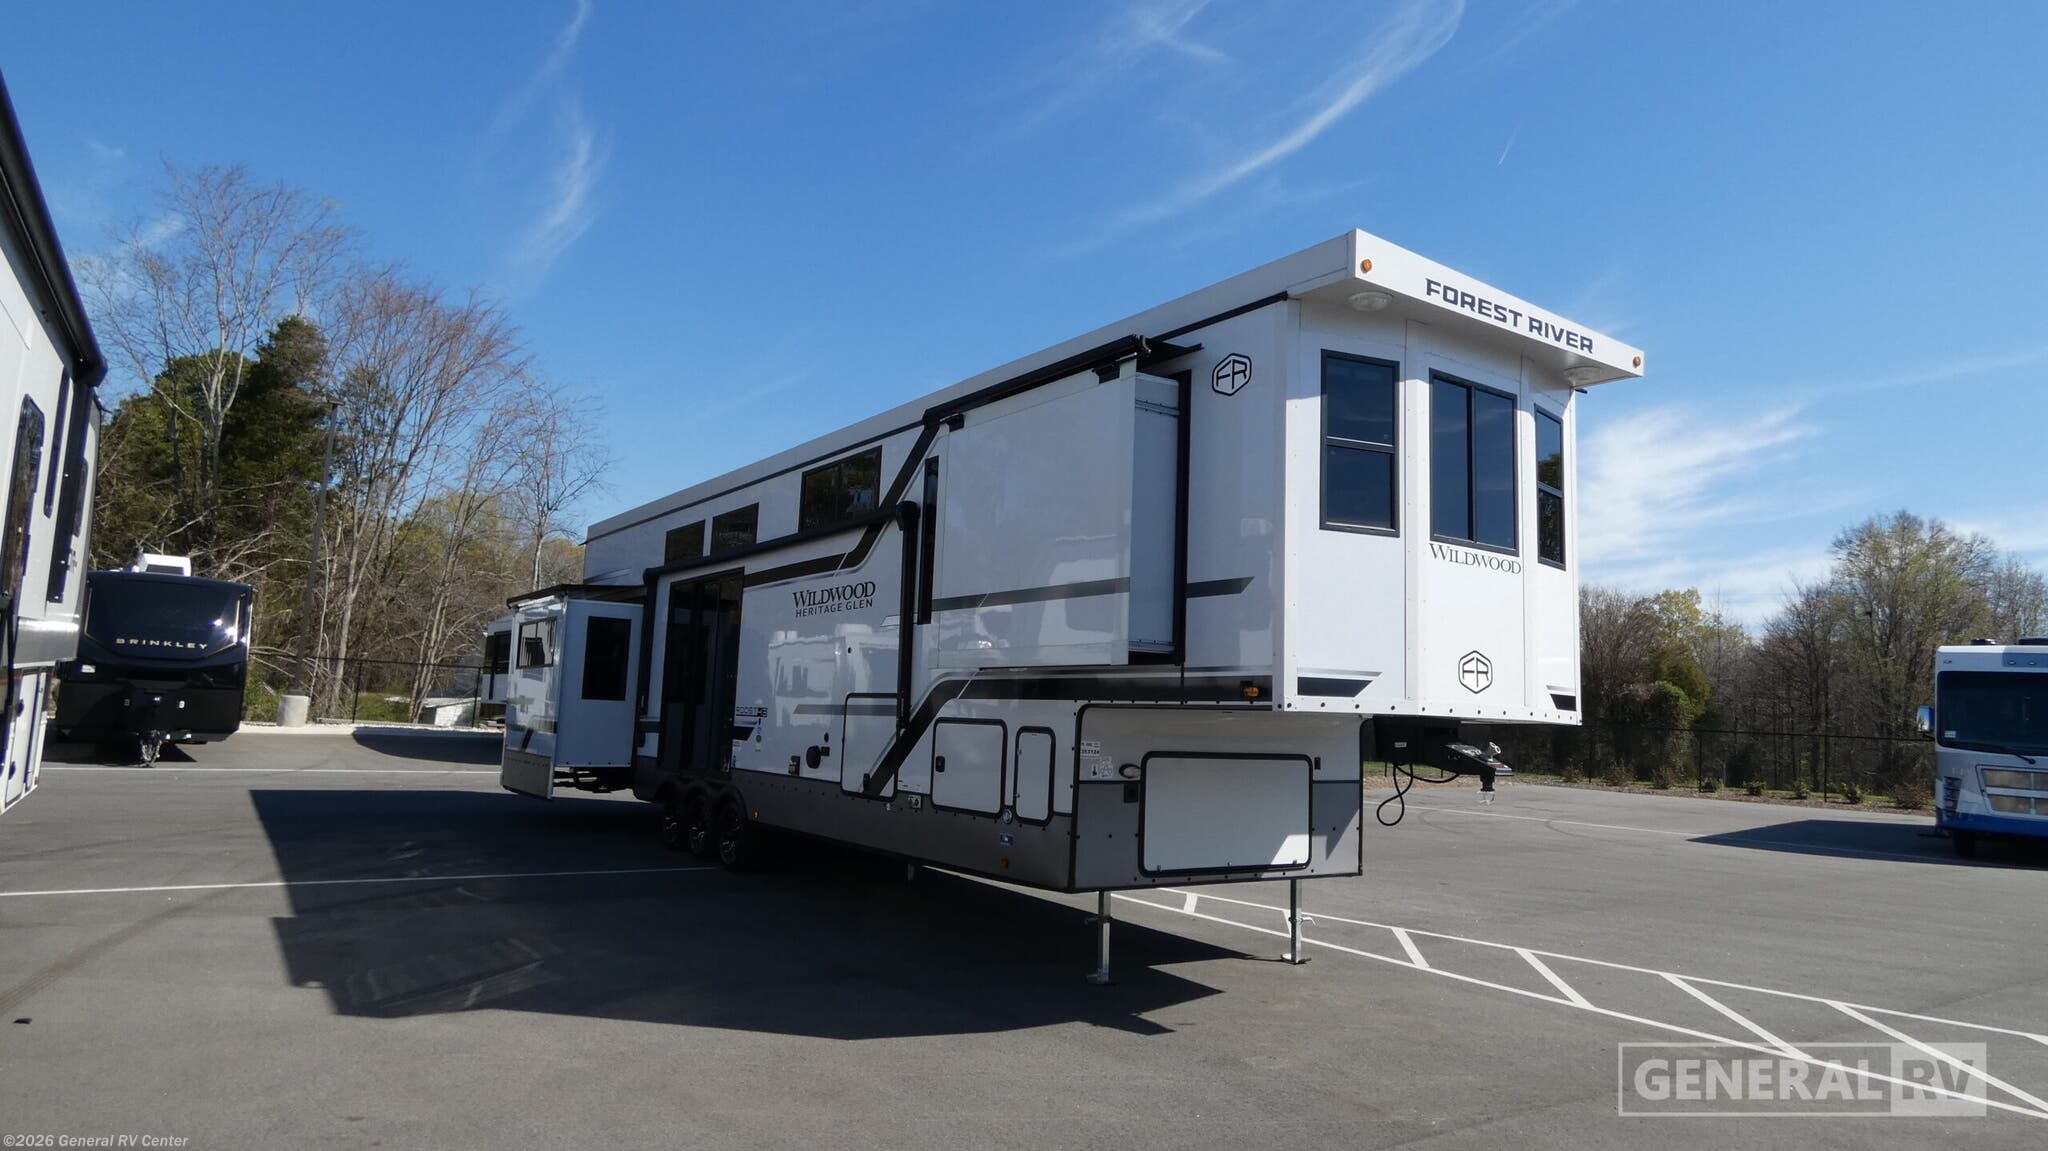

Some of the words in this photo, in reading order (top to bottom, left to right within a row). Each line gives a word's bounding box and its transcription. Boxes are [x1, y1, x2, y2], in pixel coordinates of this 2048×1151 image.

[1425, 278, 1523, 327] FOREST
[1528, 316, 1594, 354] RIVER
[1429, 543, 1522, 575] WILDWOOD
[792, 581, 876, 608] WILDWOOD
[795, 602, 843, 618] HERITAGE
[845, 598, 873, 611] GLEN
[115, 637, 208, 650] BRINKLEY
